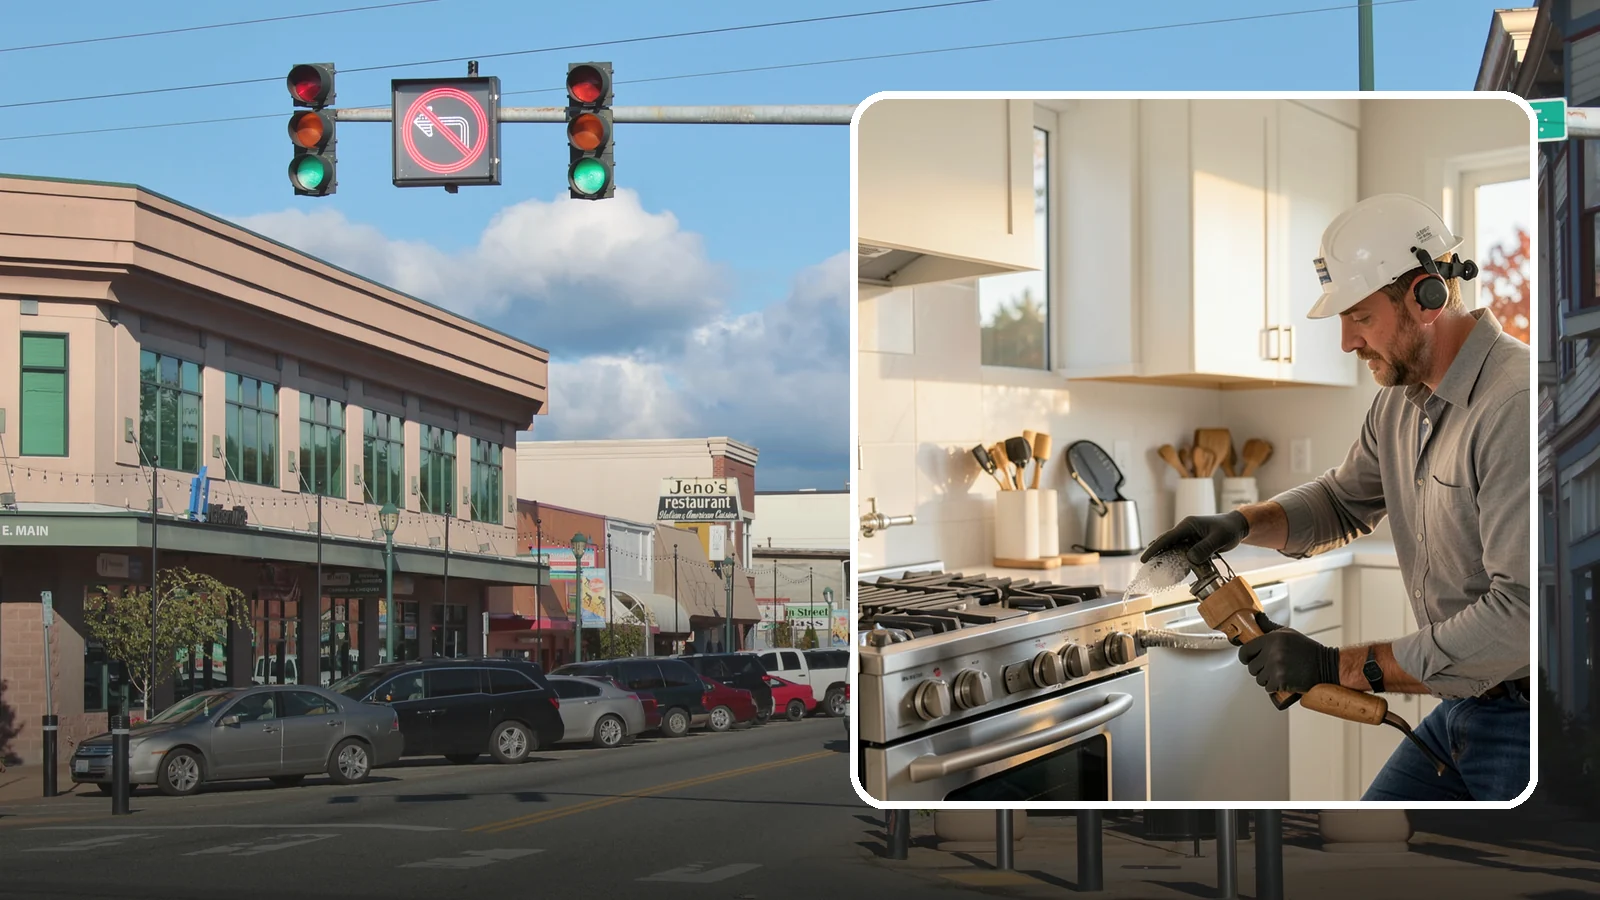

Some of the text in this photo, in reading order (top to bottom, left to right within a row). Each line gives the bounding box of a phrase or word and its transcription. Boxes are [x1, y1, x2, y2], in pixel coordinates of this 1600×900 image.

[670, 480, 727, 494] Jeno's
[665, 496, 731, 509] restaurant
[658, 510, 681, 520] Italian
[686, 509, 714, 520] American
[715, 509, 738, 520] Cuisine
[2, 525, 49, 536] E. MAIN
[797, 607, 829, 617] Street
